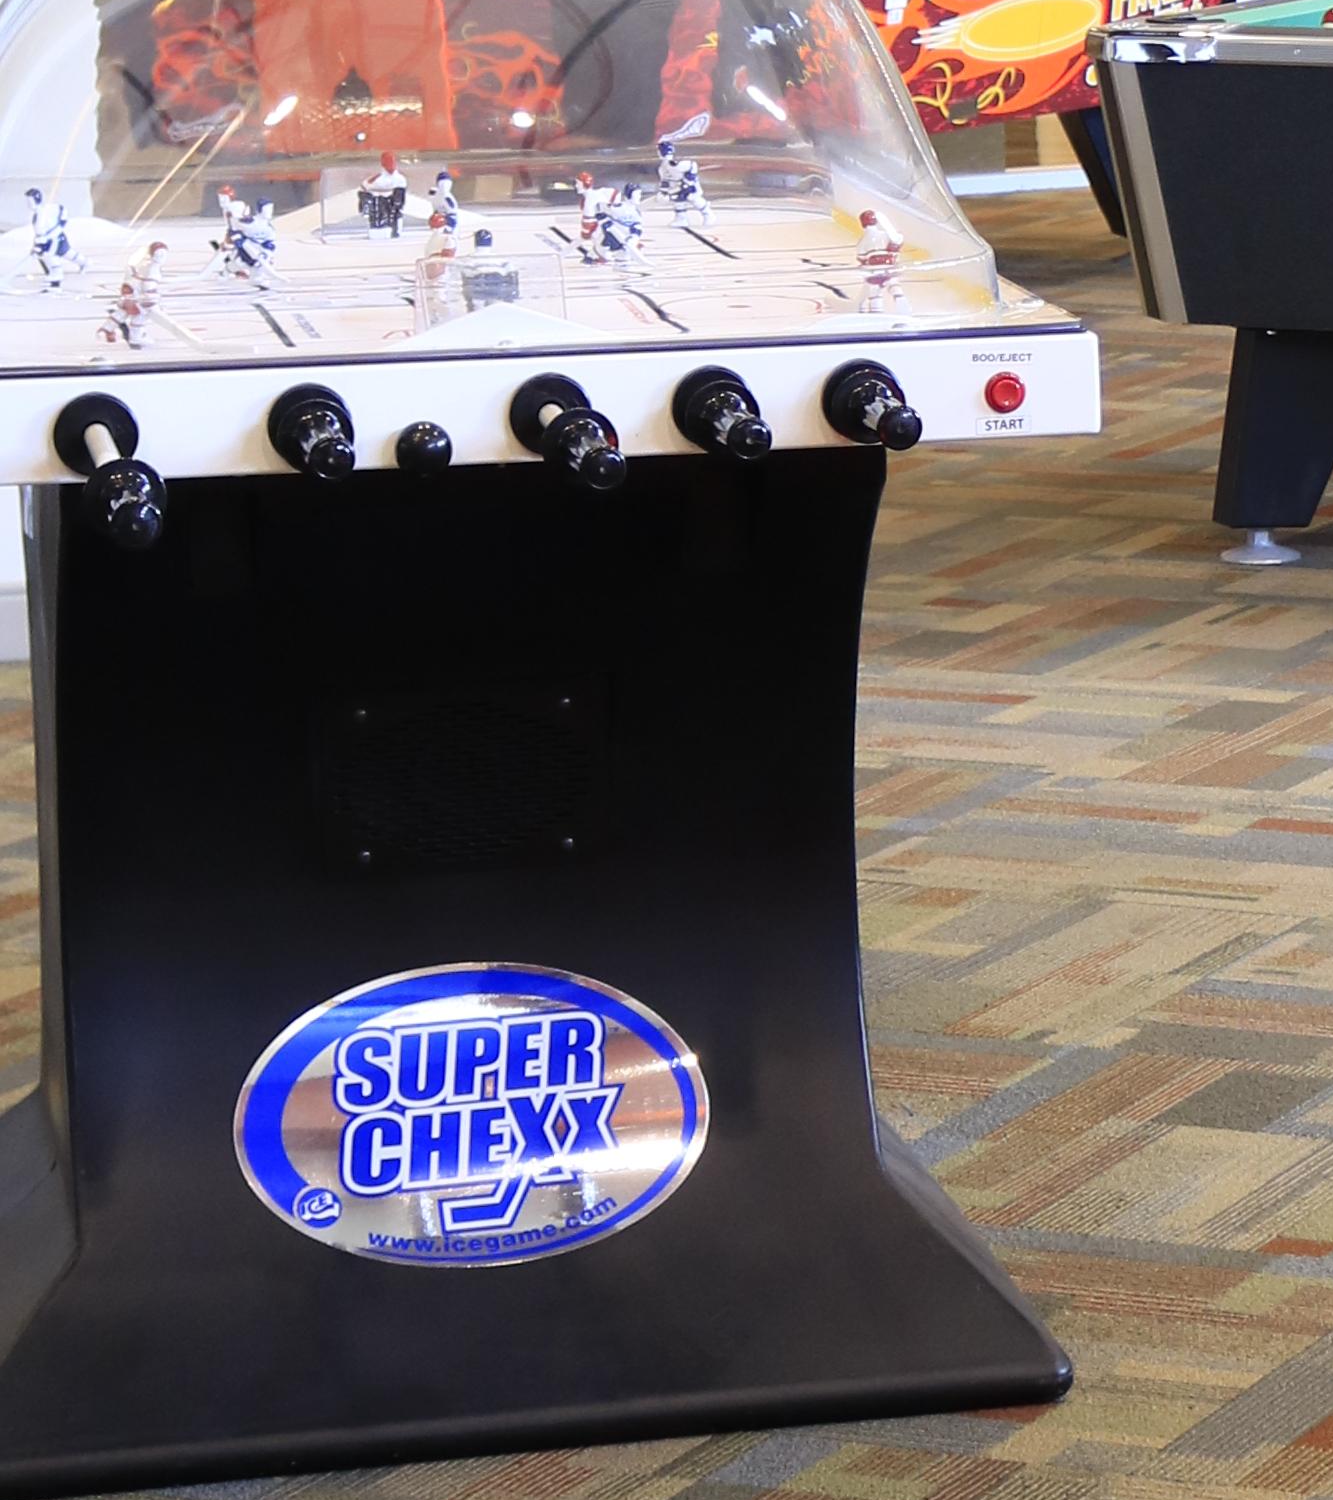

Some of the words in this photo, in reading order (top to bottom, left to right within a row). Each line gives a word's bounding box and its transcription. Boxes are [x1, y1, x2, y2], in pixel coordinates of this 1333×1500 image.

[971, 353, 1032, 362] BOO/EJECT
[984, 418, 1024, 431] START
[336, 1011, 603, 1114] SUPER
[340, 1084, 624, 1197] CHEXX
[367, 1195, 618, 1252] www.icegame.com
